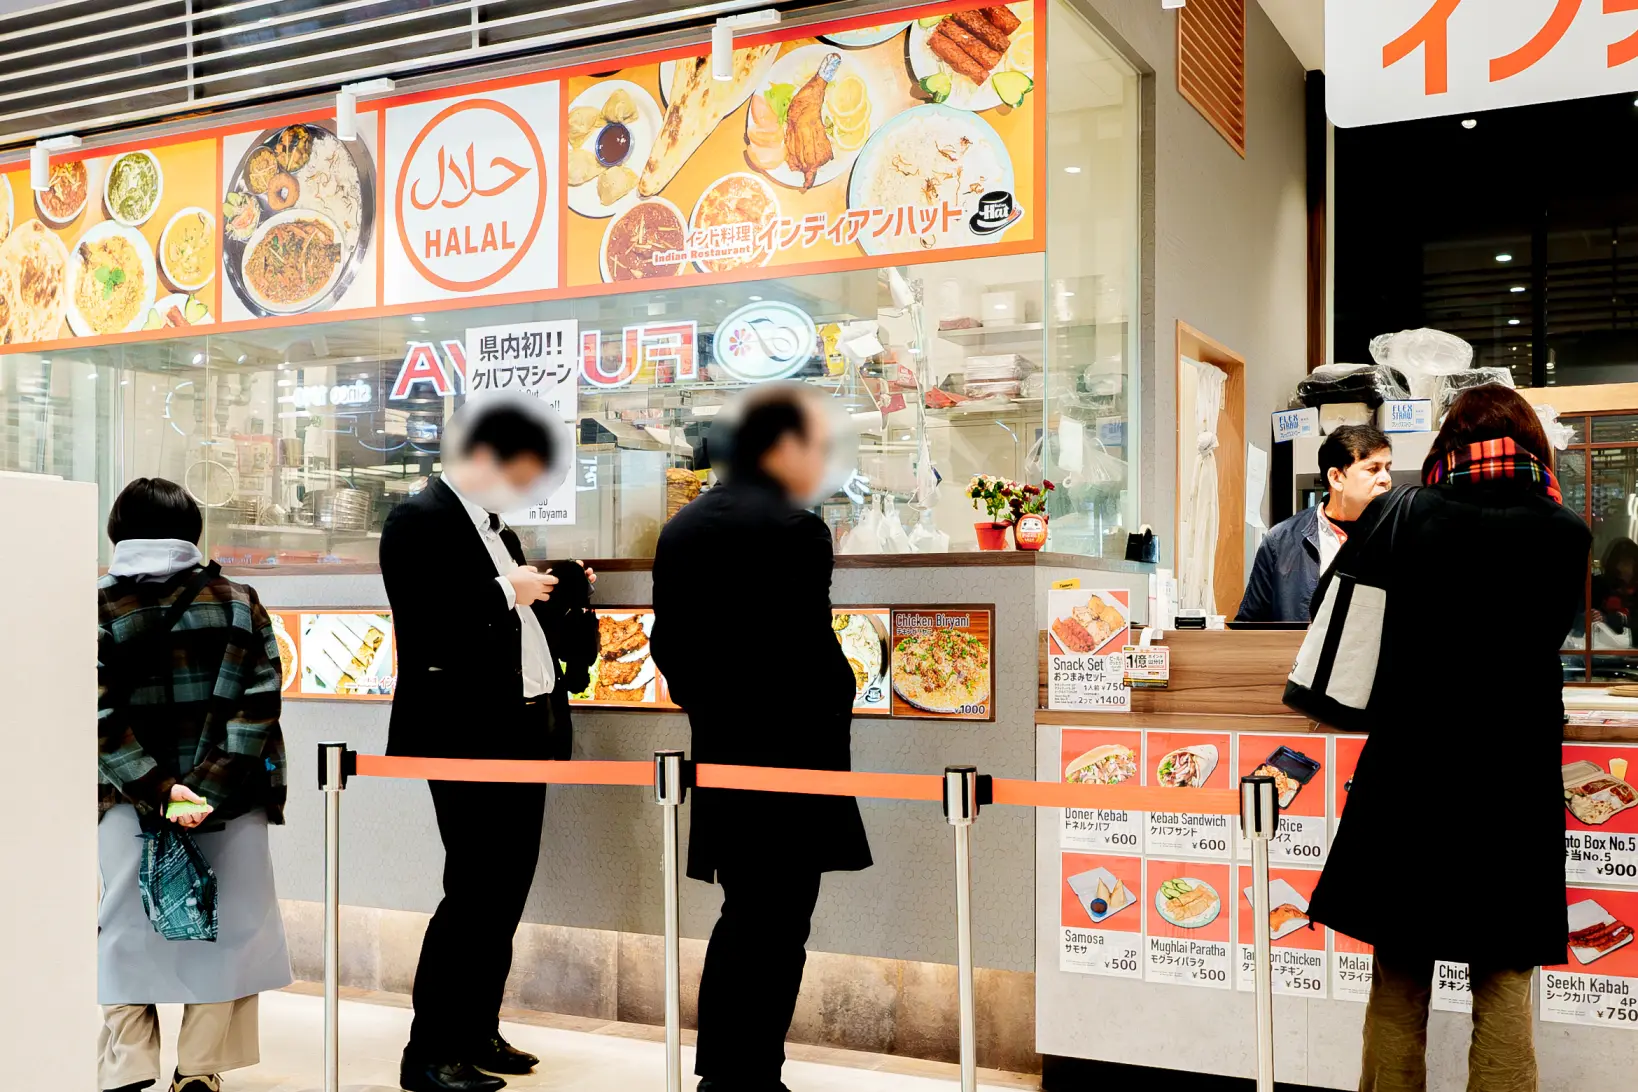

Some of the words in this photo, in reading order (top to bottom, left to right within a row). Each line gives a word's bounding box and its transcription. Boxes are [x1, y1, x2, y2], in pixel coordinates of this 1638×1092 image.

[410, 141, 532, 211] حلال
[979, 203, 1009, 219] Hat
[758, 200, 962, 250] インディアンハット
[425, 220, 516, 259] HALAL
[686, 225, 751, 248] インド料理
[654, 251, 688, 263] Indian
[690, 245, 751, 259] Restaurant
[480, 331, 562, 361] 県内初!!
[472, 364, 571, 390] ケバブマシーン
[529, 507, 536, 519] in
[539, 507, 568, 522] Toyama
[896, 613, 933, 628] Chicken
[936, 613, 970, 630] Biryani
[1053, 657, 1085, 671] Snack
[1087, 657, 1104, 671] Set
[1054, 672, 1106, 682] おつまみセット
[1096, 696, 1126, 705] ¥1400
[954, 704, 986, 714] ¥1000
[1065, 807, 1094, 820] Doner
[1097, 809, 1128, 822] Kebab
[1150, 811, 1179, 825] Kebab
[1181, 812, 1226, 827] Sandwich
[1279, 818, 1303, 832] Rice
[1104, 833, 1137, 845] ¥600
[1192, 839, 1226, 851] ¥600
[1565, 834, 1581, 849] nto
[1584, 834, 1606, 850] Box
[1609, 836, 1636, 852] No.5
[1285, 844, 1321, 857] ¥600
[1597, 863, 1637, 877] ¥900
[1065, 929, 1104, 945] Samosa
[1065, 944, 1088, 954] サモサ
[1124, 950, 1137, 958] 2P
[1151, 939, 1188, 955] Mughlai
[1190, 942, 1226, 957] Paratha
[1104, 958, 1137, 971] ¥500
[1284, 951, 1321, 967] Chicken
[1339, 955, 1370, 971] Malai
[1192, 968, 1226, 982] ¥500
[1285, 977, 1321, 991] ¥550
[1547, 974, 1585, 991] Seekh
[1589, 978, 1630, 996] Kabab
[1620, 997, 1638, 1008] 4P
[1597, 1007, 1638, 1022] ¥750
